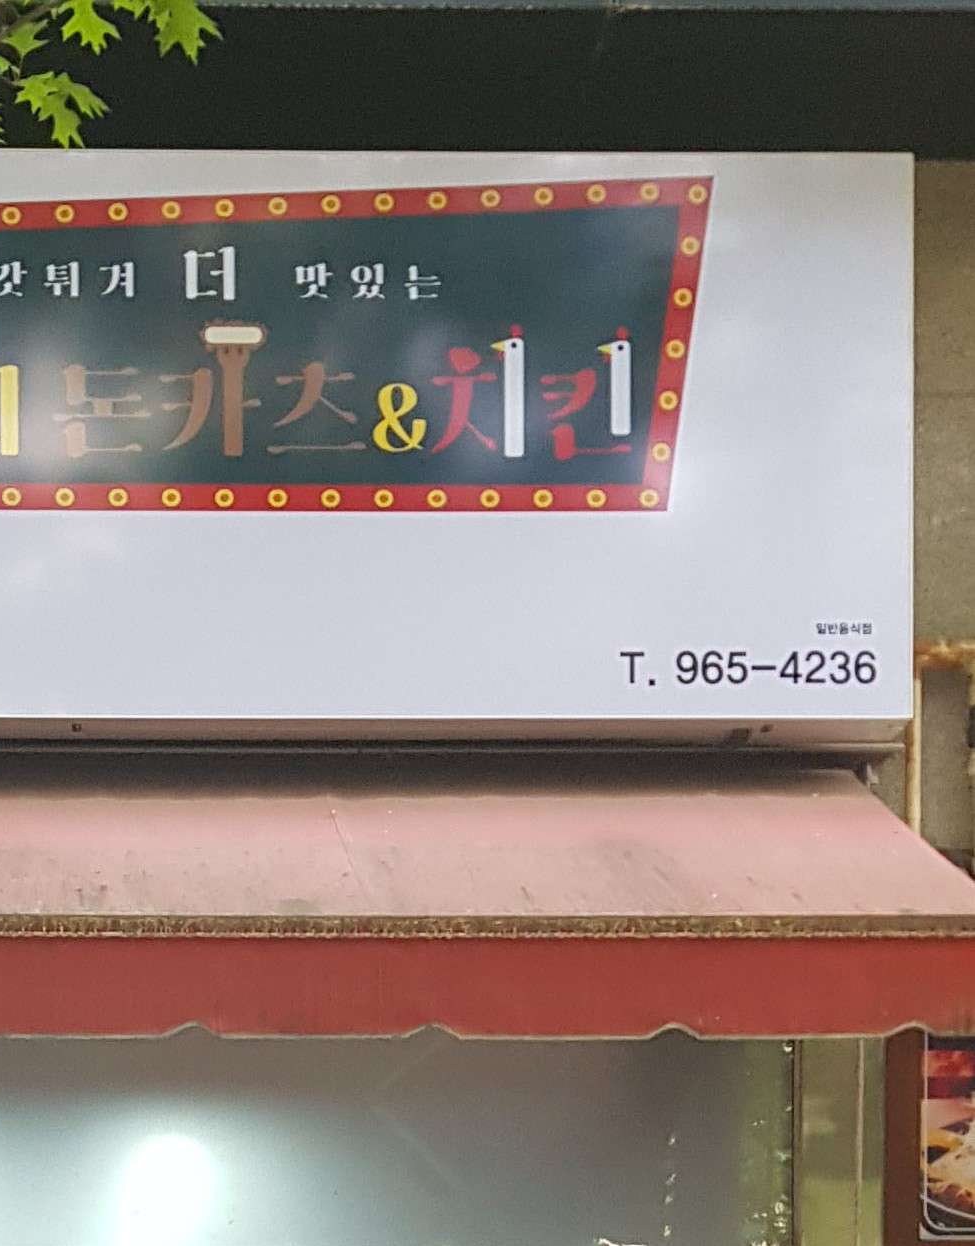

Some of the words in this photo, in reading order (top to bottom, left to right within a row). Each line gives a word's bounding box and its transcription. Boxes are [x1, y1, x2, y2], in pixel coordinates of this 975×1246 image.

[184, 246, 237, 301] 더
[294, 262, 442, 300] 맛있는
[620, 652, 656, 686] T.
[676, 650, 877, 685] 965-4236
